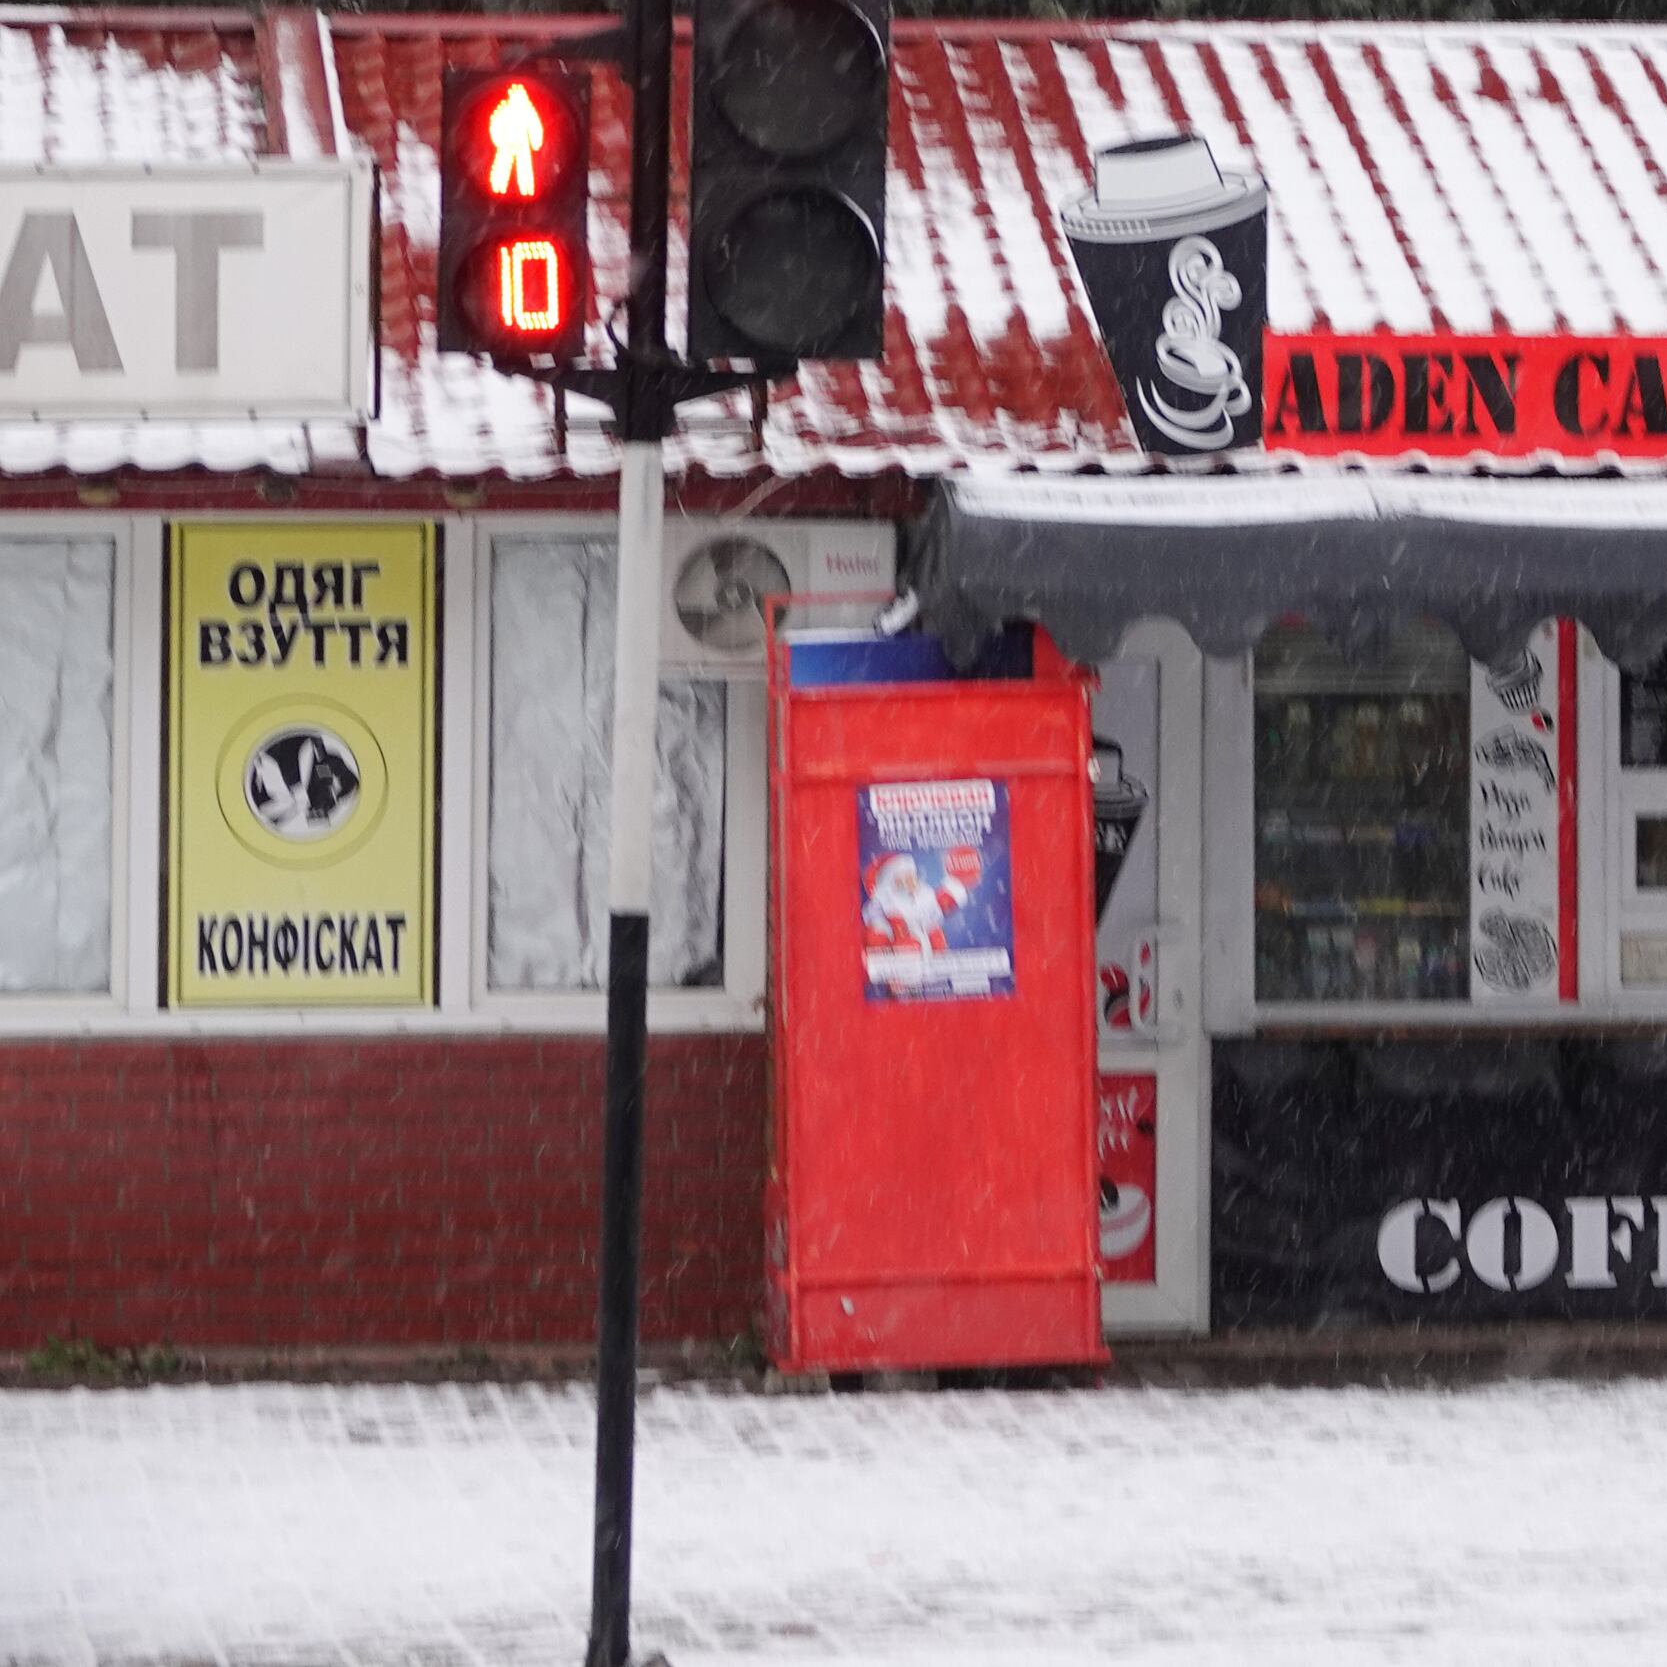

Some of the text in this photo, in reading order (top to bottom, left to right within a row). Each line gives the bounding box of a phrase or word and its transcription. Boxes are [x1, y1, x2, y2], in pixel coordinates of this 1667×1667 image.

[1270, 350, 1522, 437] ADEN
[228, 560, 381, 612] ОДЯГ
[199, 618, 409, 670] ВЗУТТЯ
[197, 912, 408, 978] КОНФІСКАТ
